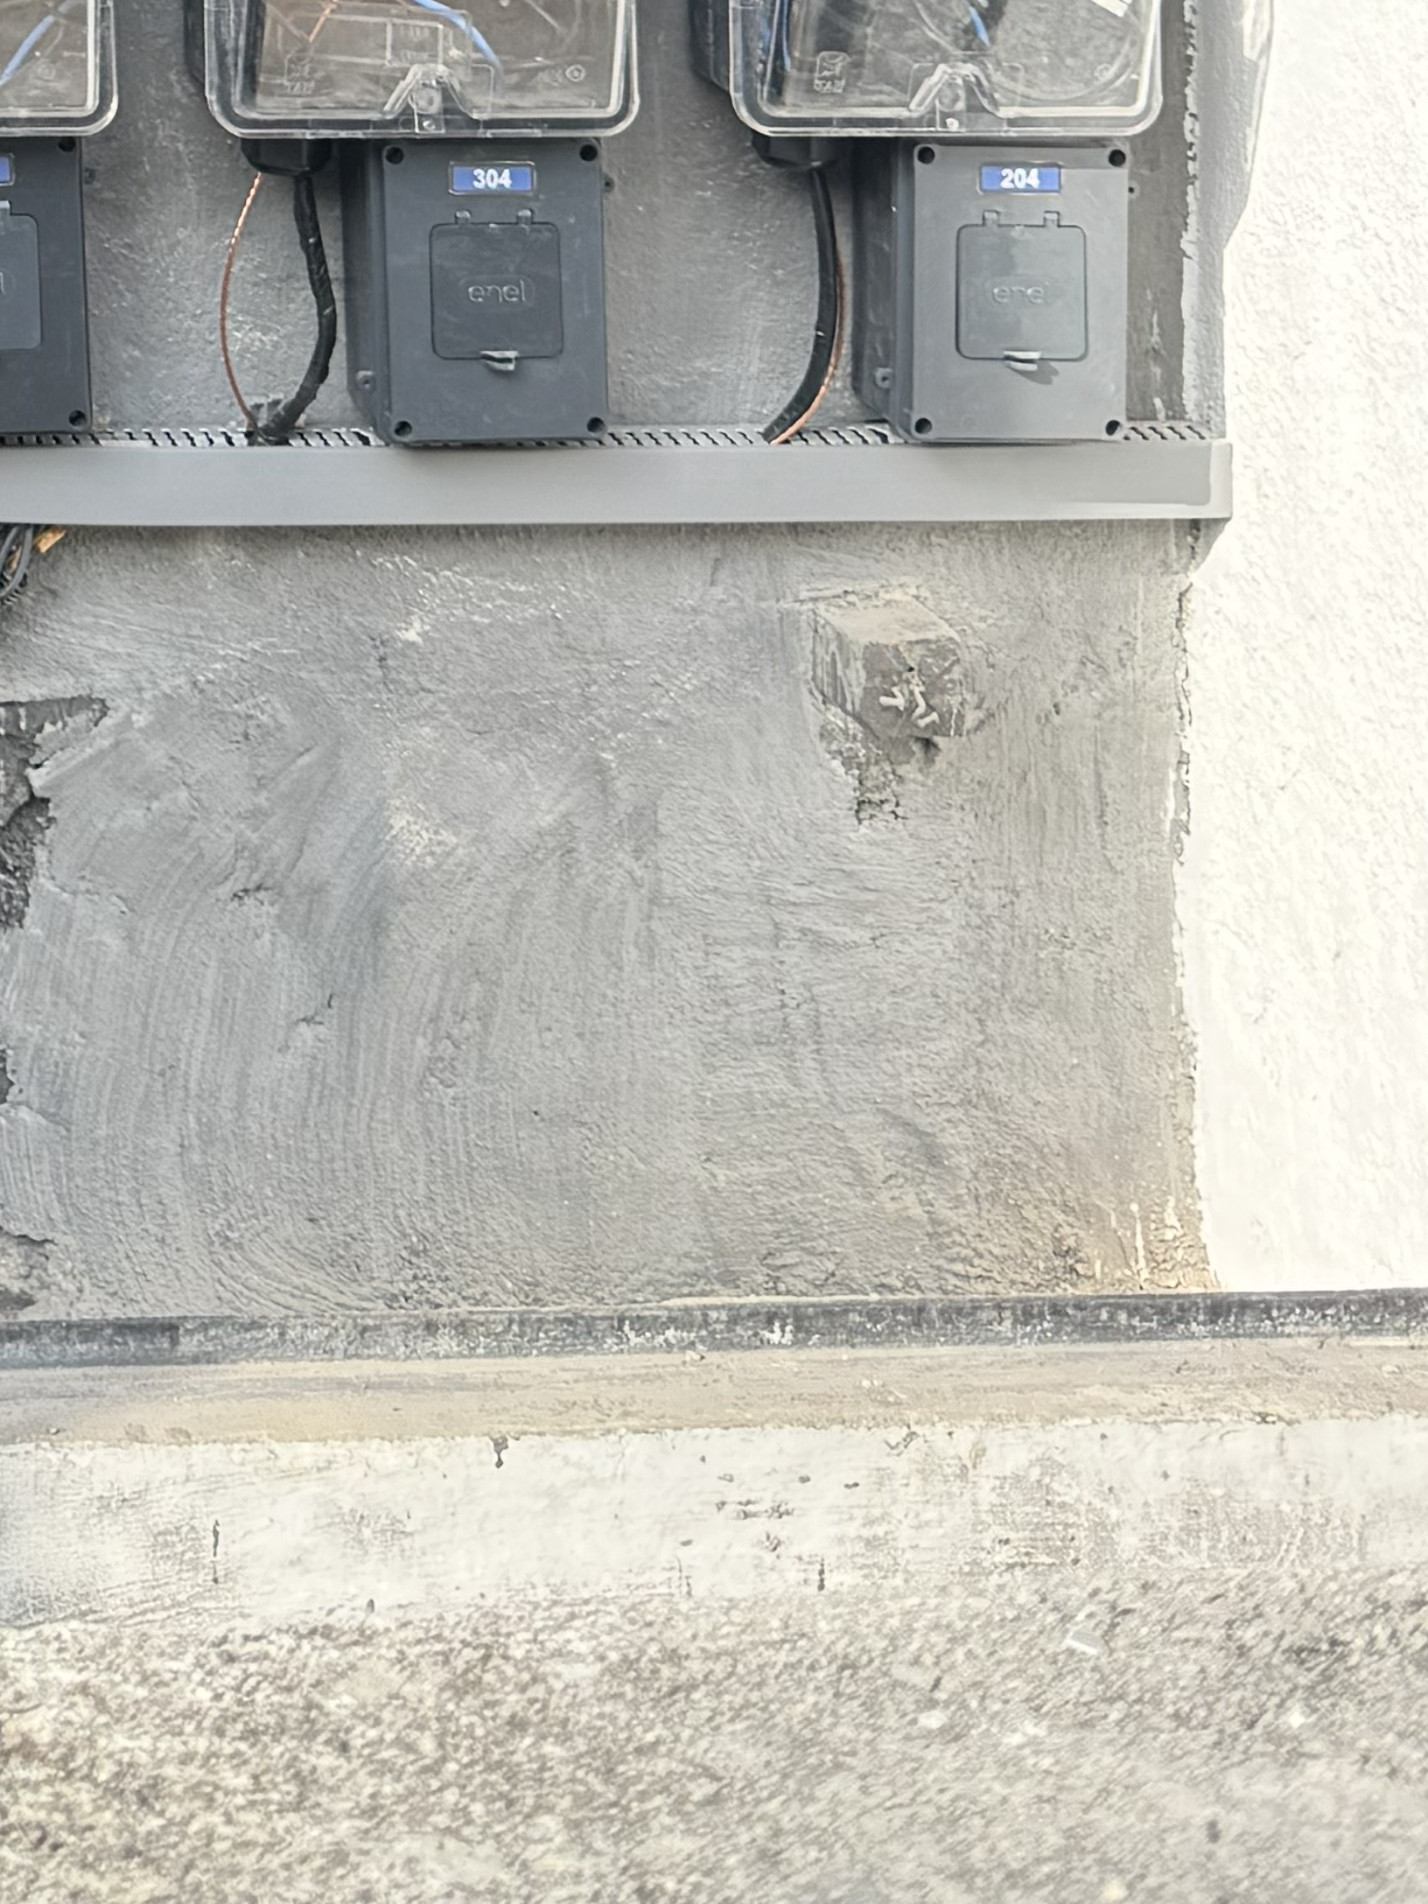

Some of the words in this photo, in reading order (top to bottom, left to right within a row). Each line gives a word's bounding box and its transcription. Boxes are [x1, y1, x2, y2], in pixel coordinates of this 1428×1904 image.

[472, 168, 512, 189] 304
[999, 167, 1041, 189] 204
[467, 279, 526, 304] enel
